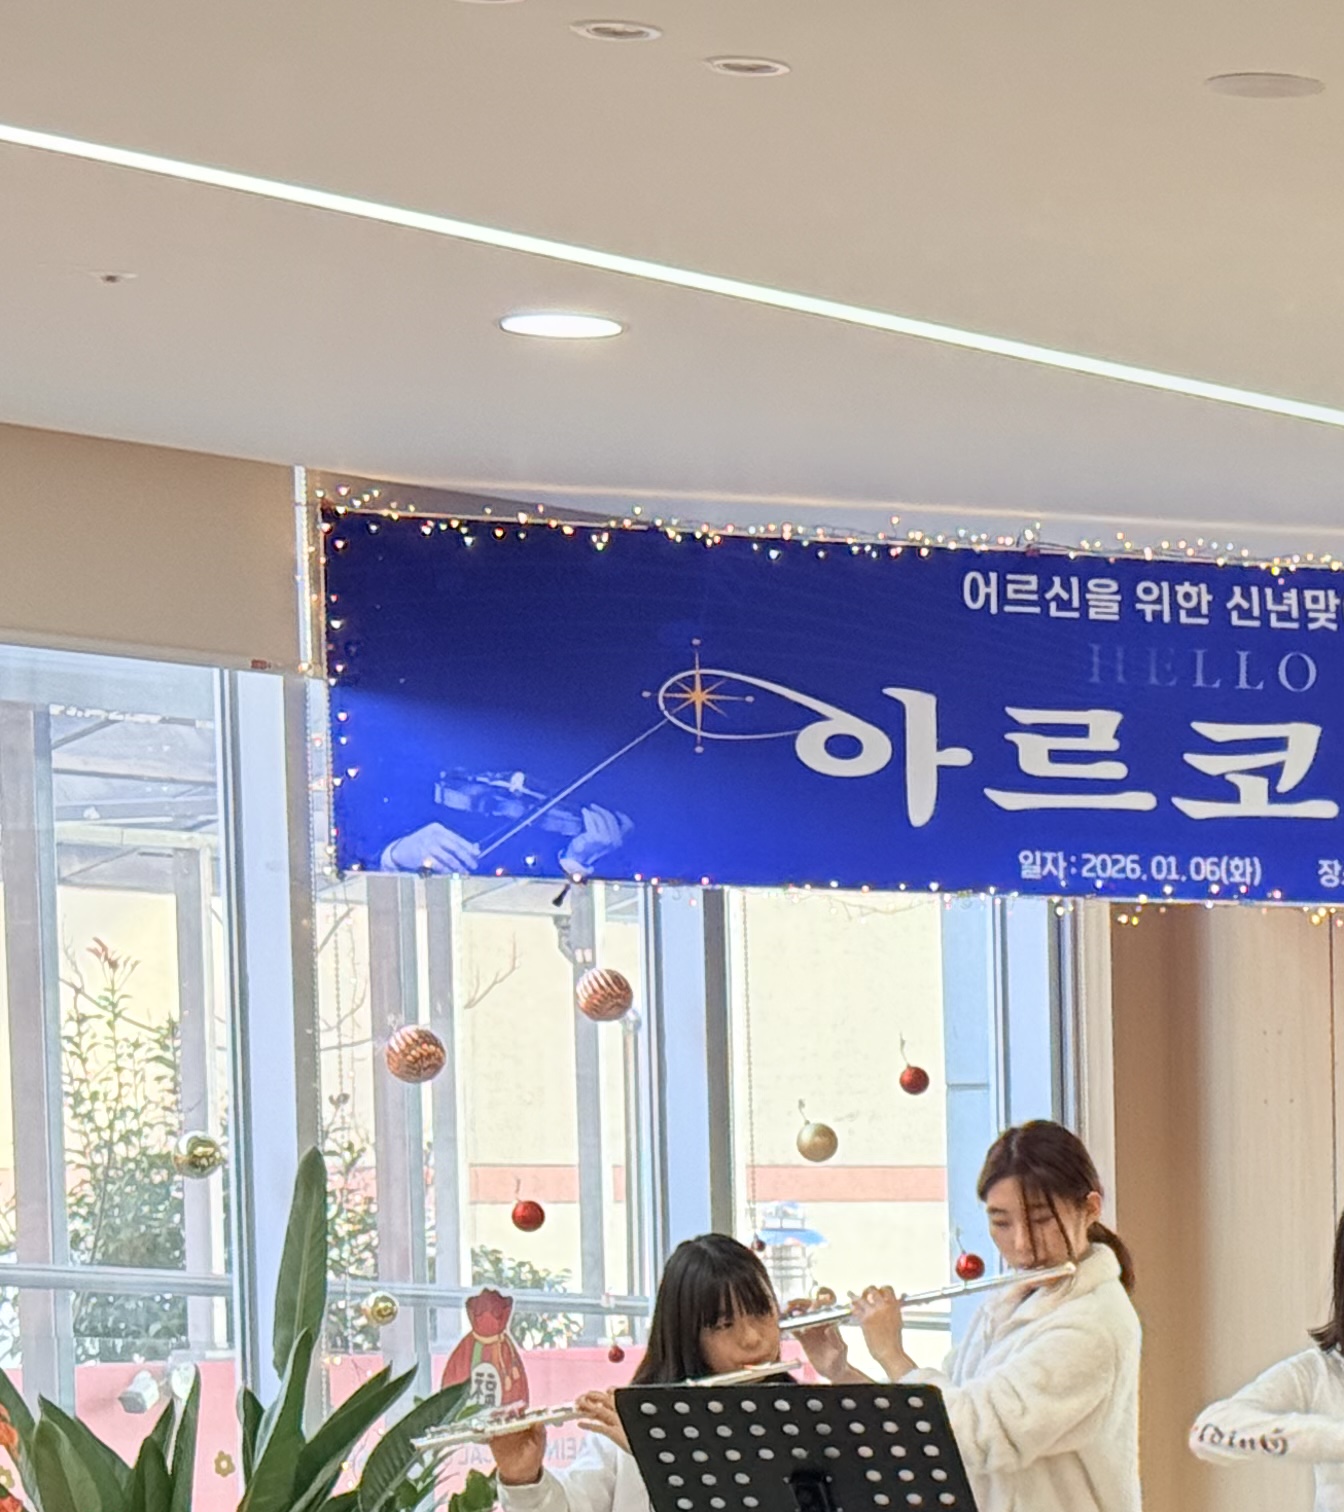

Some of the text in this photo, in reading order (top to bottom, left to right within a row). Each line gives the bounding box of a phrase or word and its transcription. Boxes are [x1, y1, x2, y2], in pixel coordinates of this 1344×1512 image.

[962, 570, 1122, 621] 어르신을
[1134, 580, 1214, 626] 위한
[1087, 642, 1317, 693] HELLO
[796, 686, 1339, 829] 아르코
